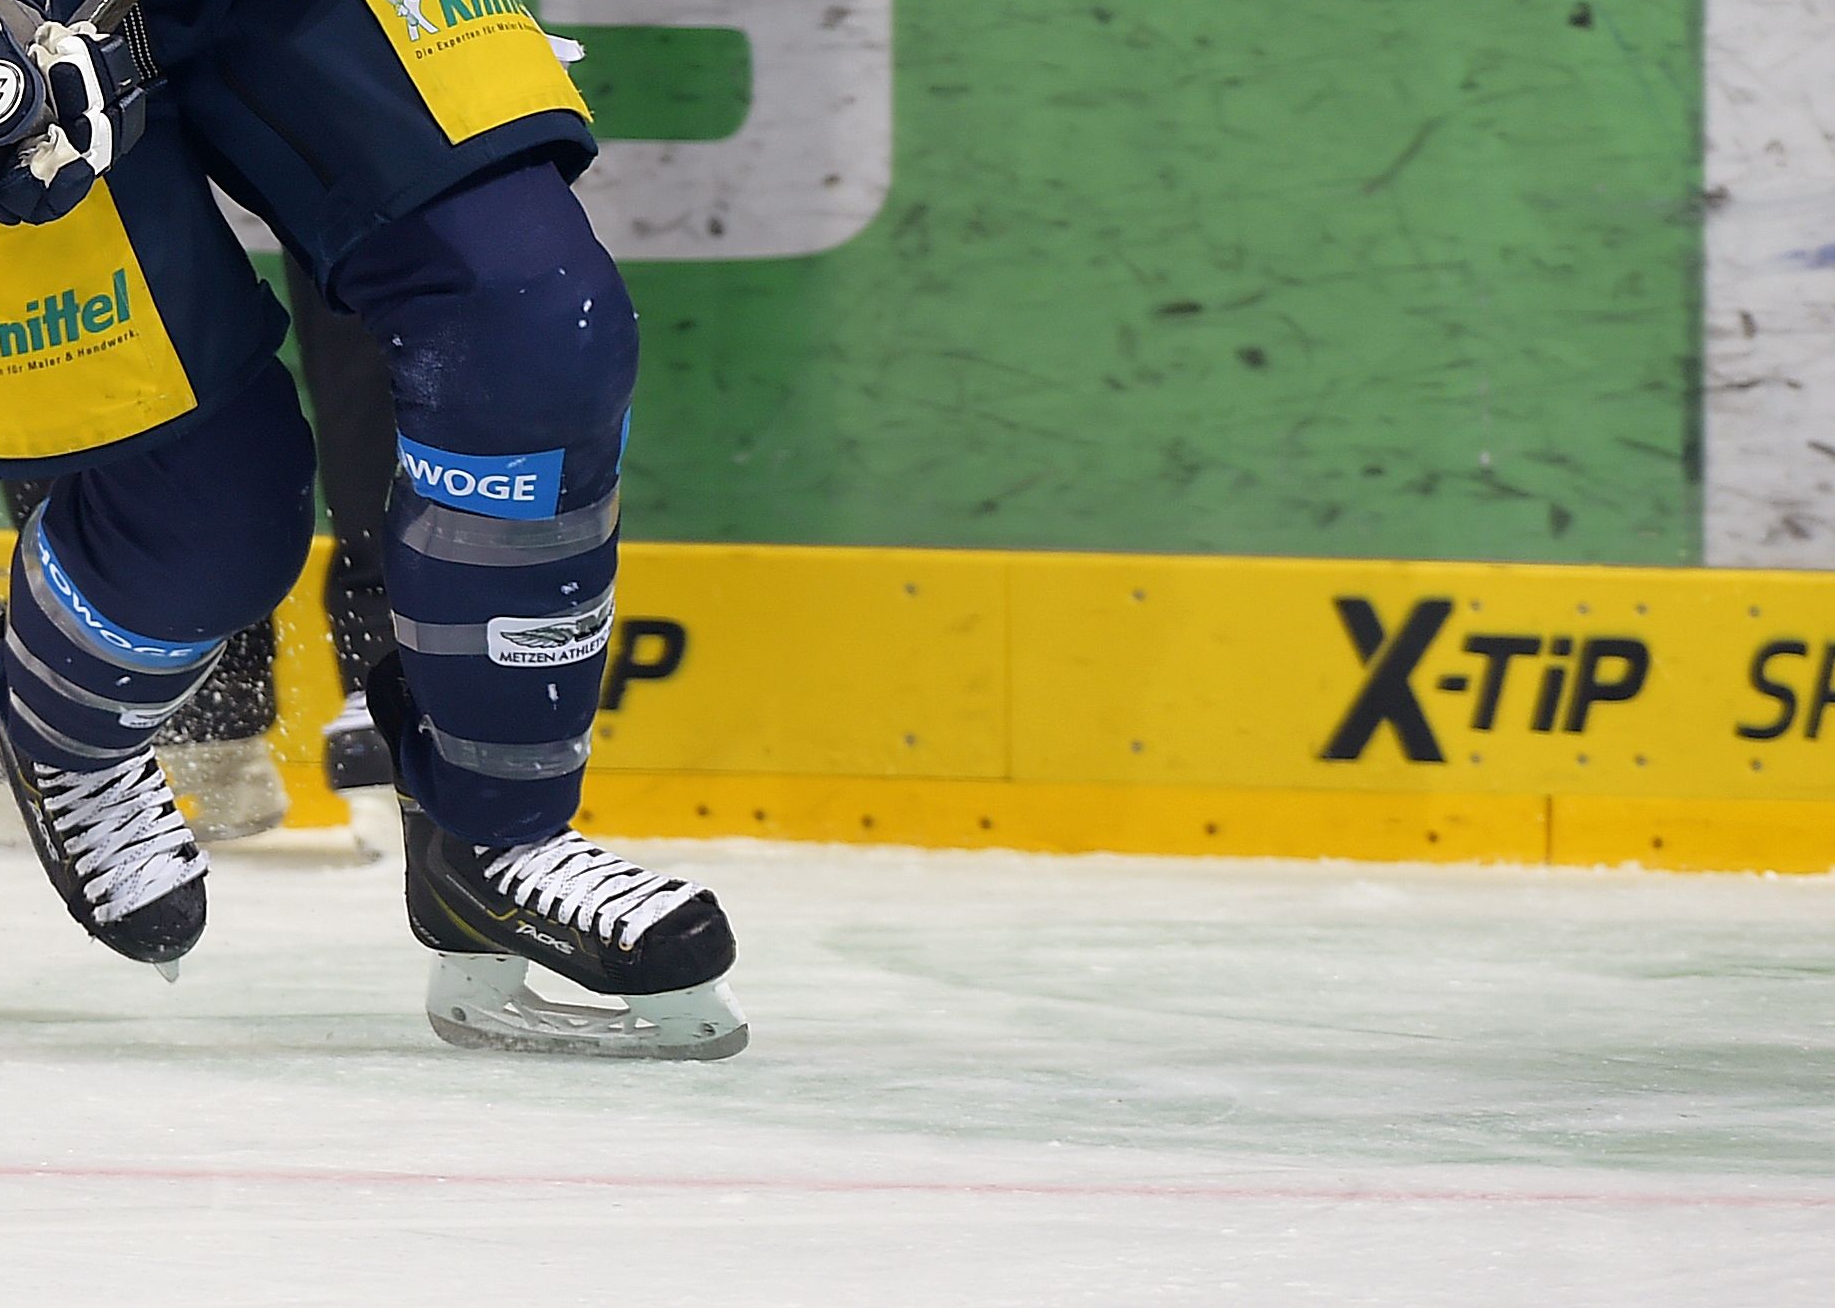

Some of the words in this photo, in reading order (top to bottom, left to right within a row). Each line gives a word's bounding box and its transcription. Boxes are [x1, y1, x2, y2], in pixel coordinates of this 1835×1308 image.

[415, 46, 434, 60] Die
[436, 28, 481, 51] Experten
[27, 356, 62, 371] Maler
[64, 350, 74, 362] &
[499, 650, 556, 664] METZEN
